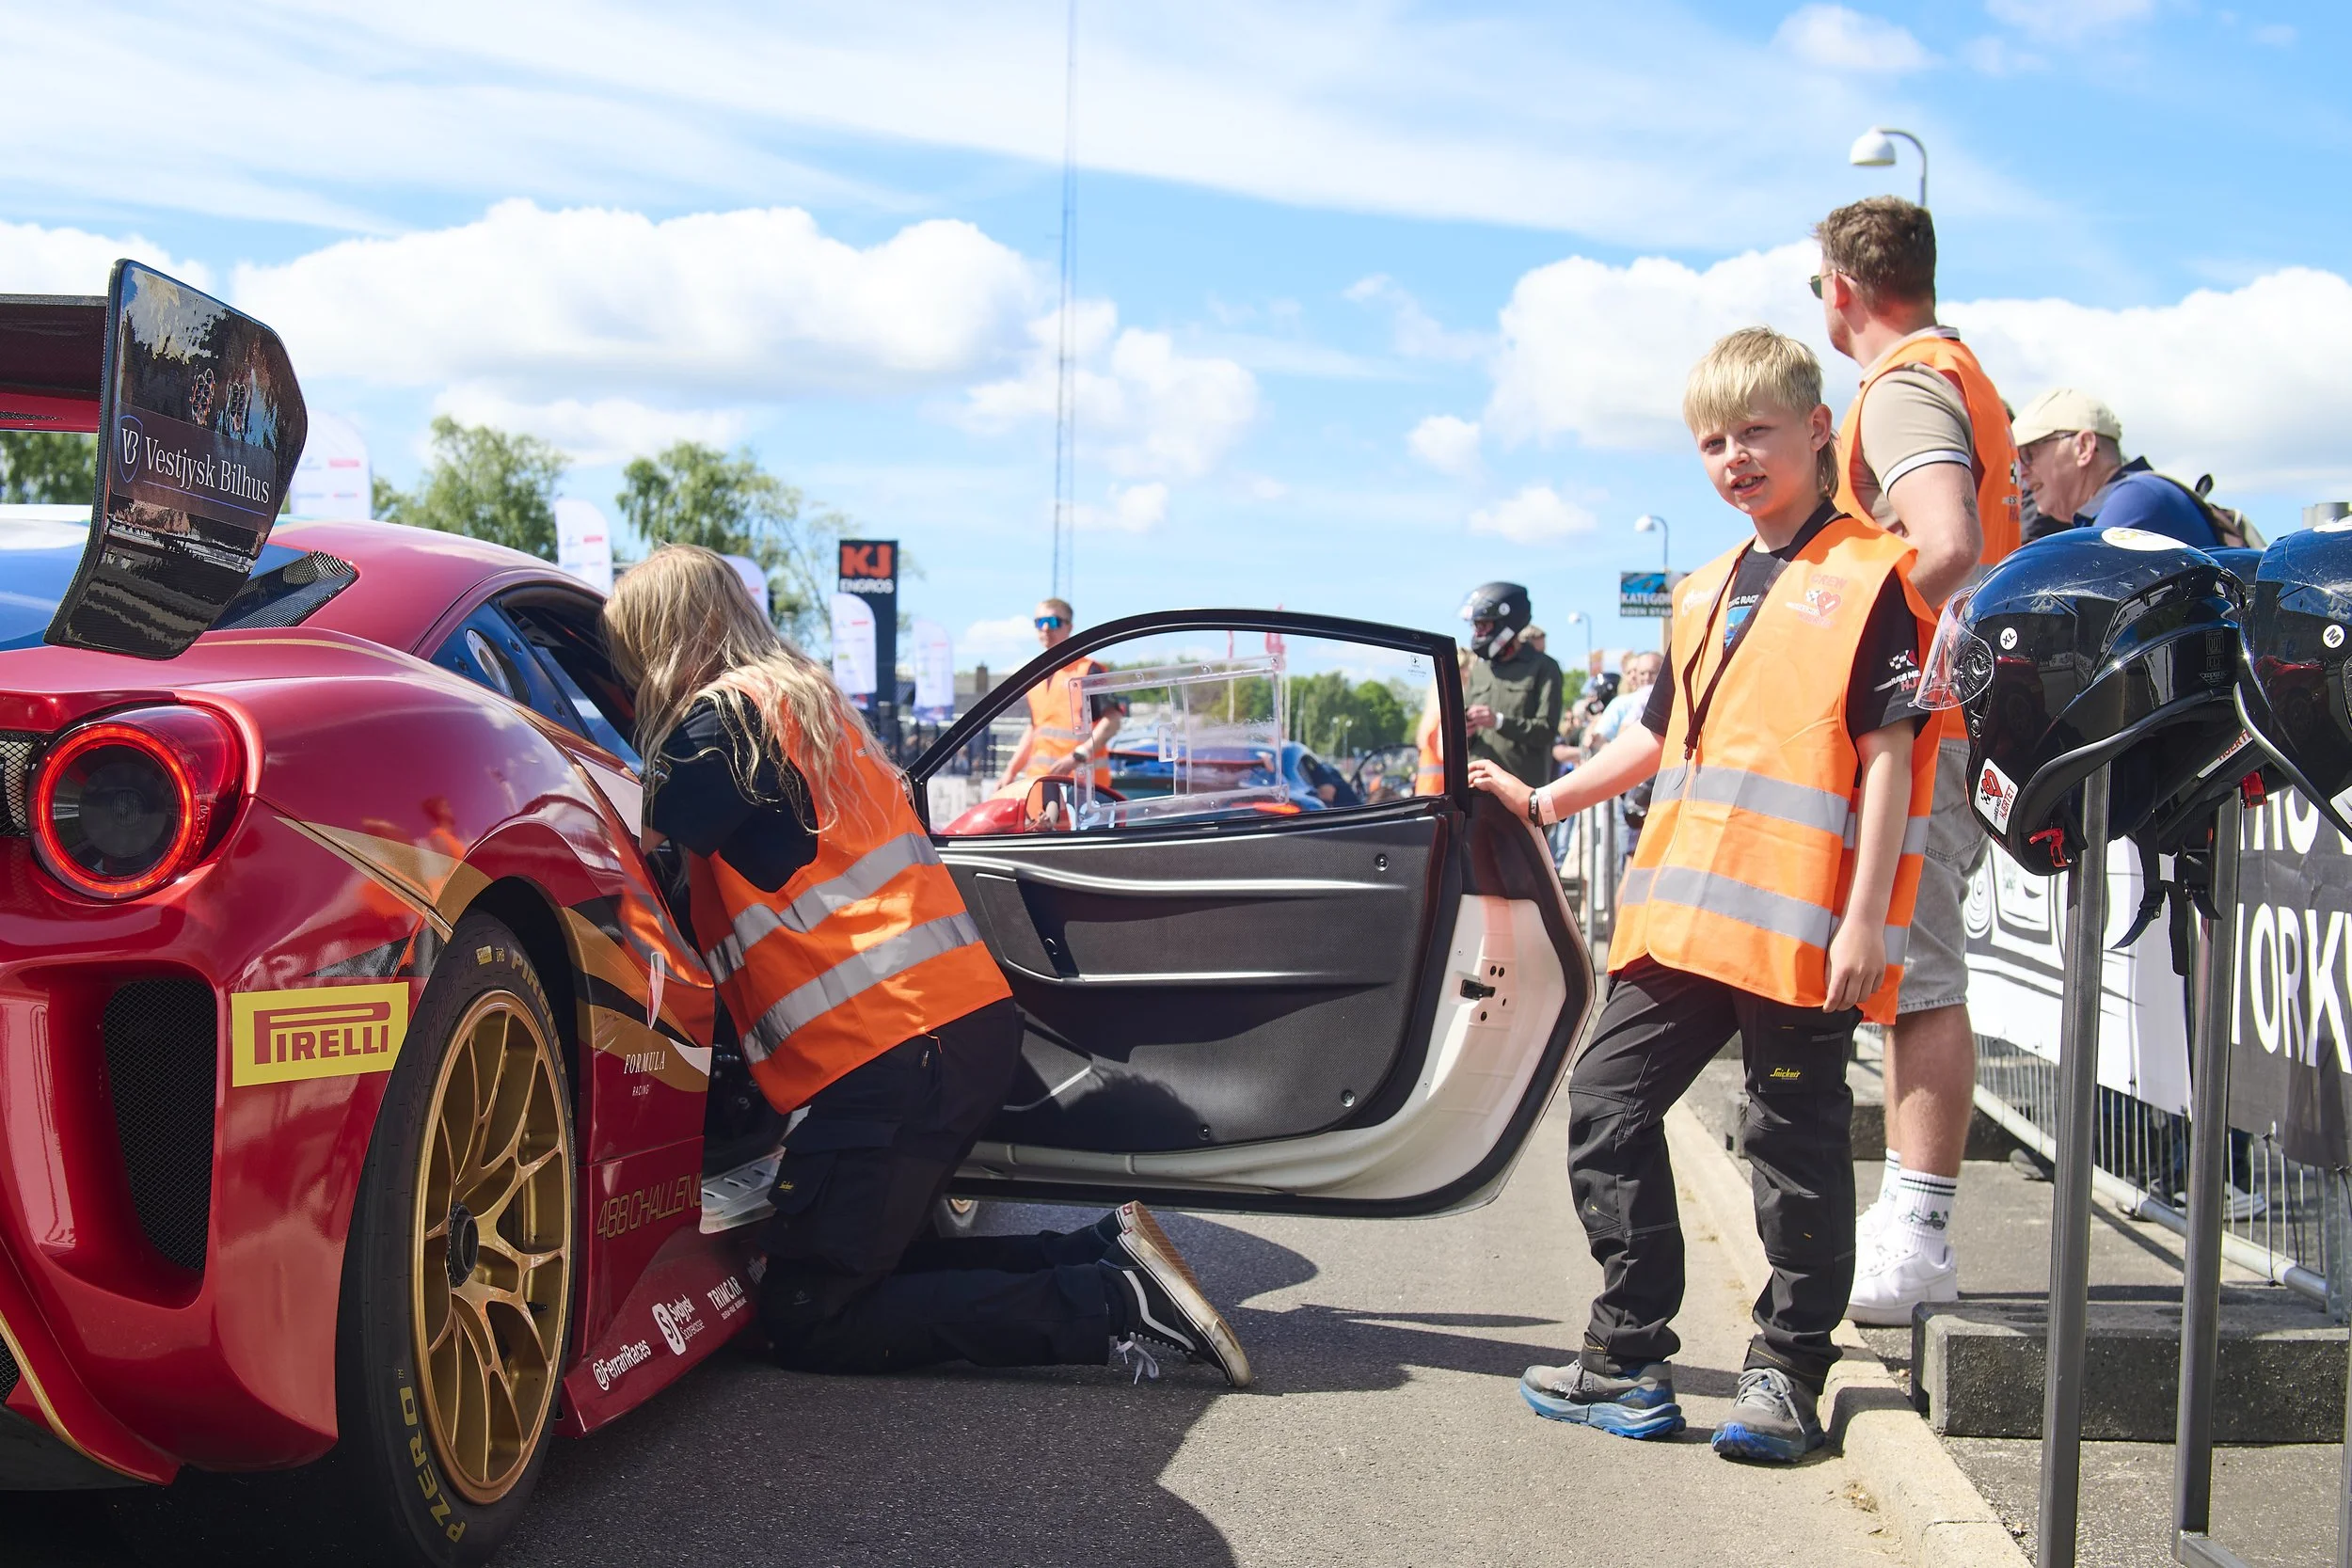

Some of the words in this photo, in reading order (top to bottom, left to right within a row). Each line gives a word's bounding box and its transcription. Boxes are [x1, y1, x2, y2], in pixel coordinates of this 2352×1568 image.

[145, 436, 216, 490] Vestjysk
[219, 459, 270, 504] Bilhus
[841, 544, 892, 578] KJ
[2002, 633, 2015, 645] XL
[2326, 627, 2342, 644] M
[1999, 784, 2015, 821] HJERTET
[511, 949, 566, 1074] PIRELLI
[253, 1001, 391, 1065] PIRELLI
[623, 1051, 666, 1074] FORMULA
[631, 1084, 649, 1097] RACING
[596, 1194, 630, 1240] 488
[666, 1293, 696, 1325] Sydjysk
[707, 1275, 743, 1311] TRIMCAR
[593, 1339, 652, 1391] @FerrariRaces
